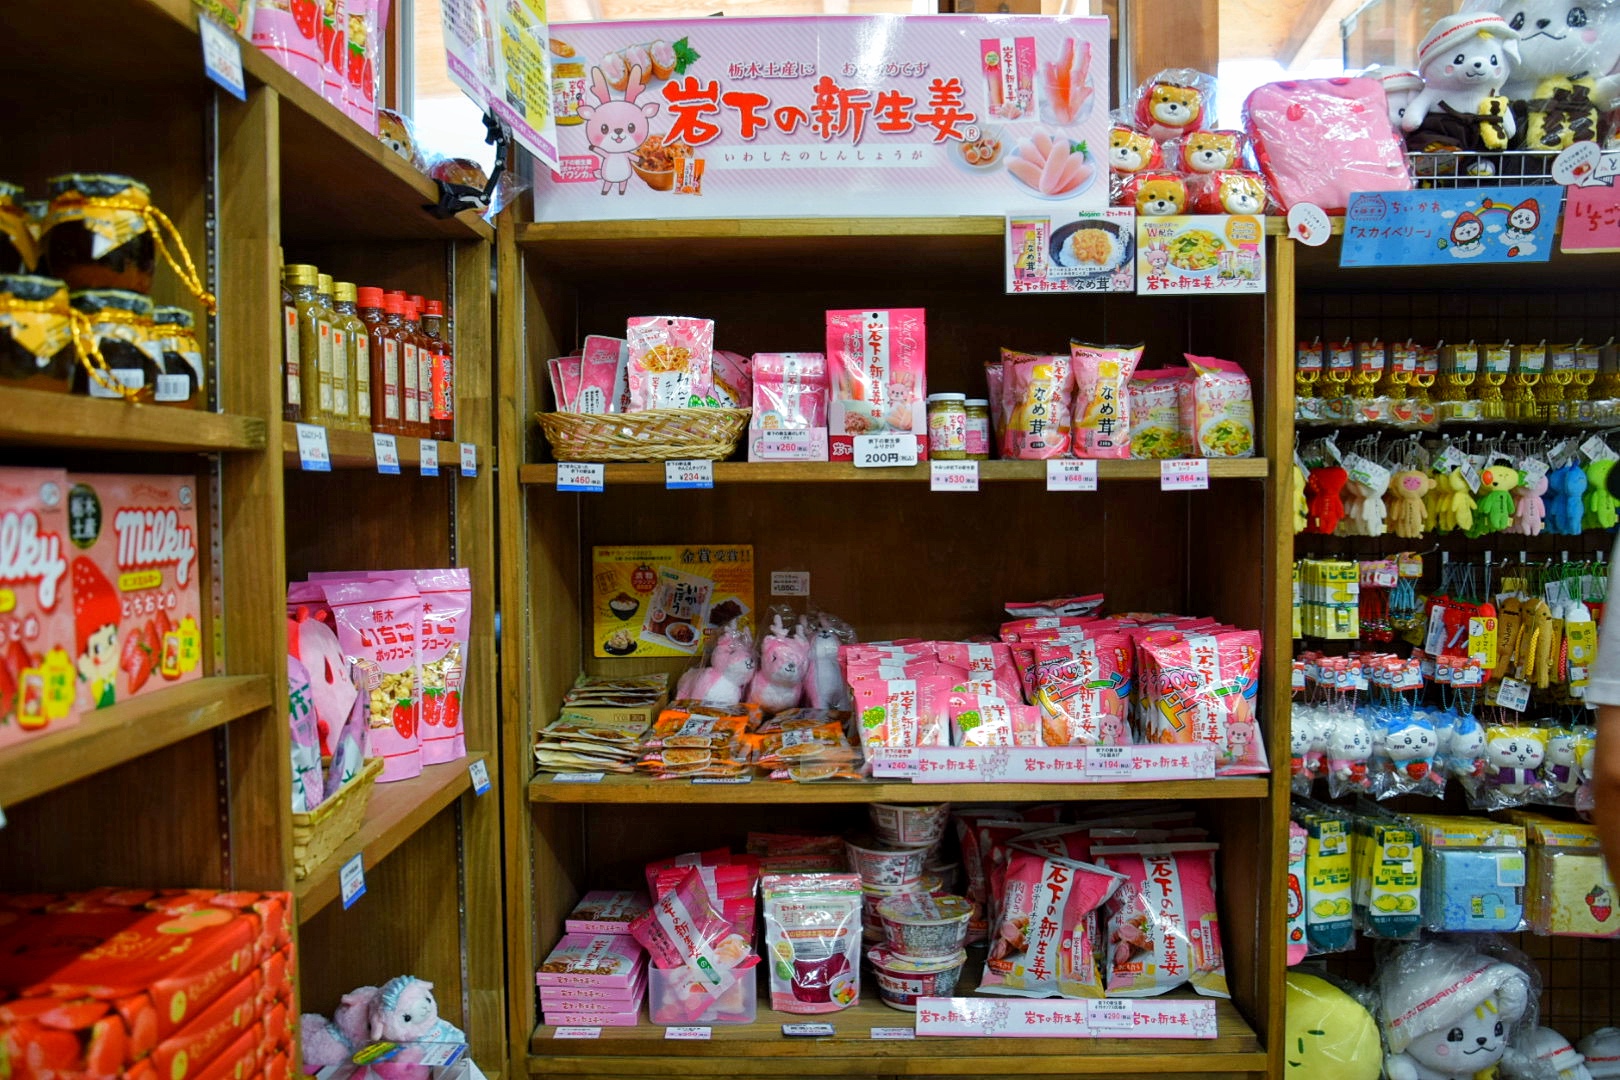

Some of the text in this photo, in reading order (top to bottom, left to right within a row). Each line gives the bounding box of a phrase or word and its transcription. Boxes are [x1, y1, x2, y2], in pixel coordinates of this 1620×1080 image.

[728, 62, 928, 78] 栃木土産に おめです
[662, 76, 975, 145] 岩下の新生姜
[724, 150, 924, 162] いわしたのしんしょうが
[1013, 280, 1069, 292] 岩下の新生姜
[1075, 277, 1110, 292] なめ茸
[1146, 275, 1214, 290] 岩下の新生姜
[867, 323, 884, 405] 岩下の新生姜
[1029, 387, 1047, 437] なめ茸
[1097, 386, 1116, 436] なめ茸
[776, 443, 796, 451] ¥260
[865, 453, 898, 463] 200円
[680, 473, 699, 481] ¥234
[944, 475, 965, 483] ¥530
[71, 497, 95, 517] 栃木
[72, 518, 96, 538] 土産
[115, 509, 195, 585] Milky
[0, 511, 66, 608] lky
[122, 592, 176, 617] とちおとめ
[373, 610, 394, 623] 栃木
[359, 623, 414, 647] いちご
[1195, 646, 1223, 744] 岩下新生姜
[919, 759, 977, 772] 岩下の新生姜
[1025, 758, 1085, 771] 岩下の新生姜
[1099, 760, 1119, 768] ¥194
[1132, 756, 1190, 770] 岩下の新生姜
[1313, 873, 1350, 886] レモン
[1376, 875, 1418, 886] レモン
[1025, 1011, 1083, 1024] 岩下の新生姜
[1133, 1011, 1189, 1025] 岩下の新生姜
